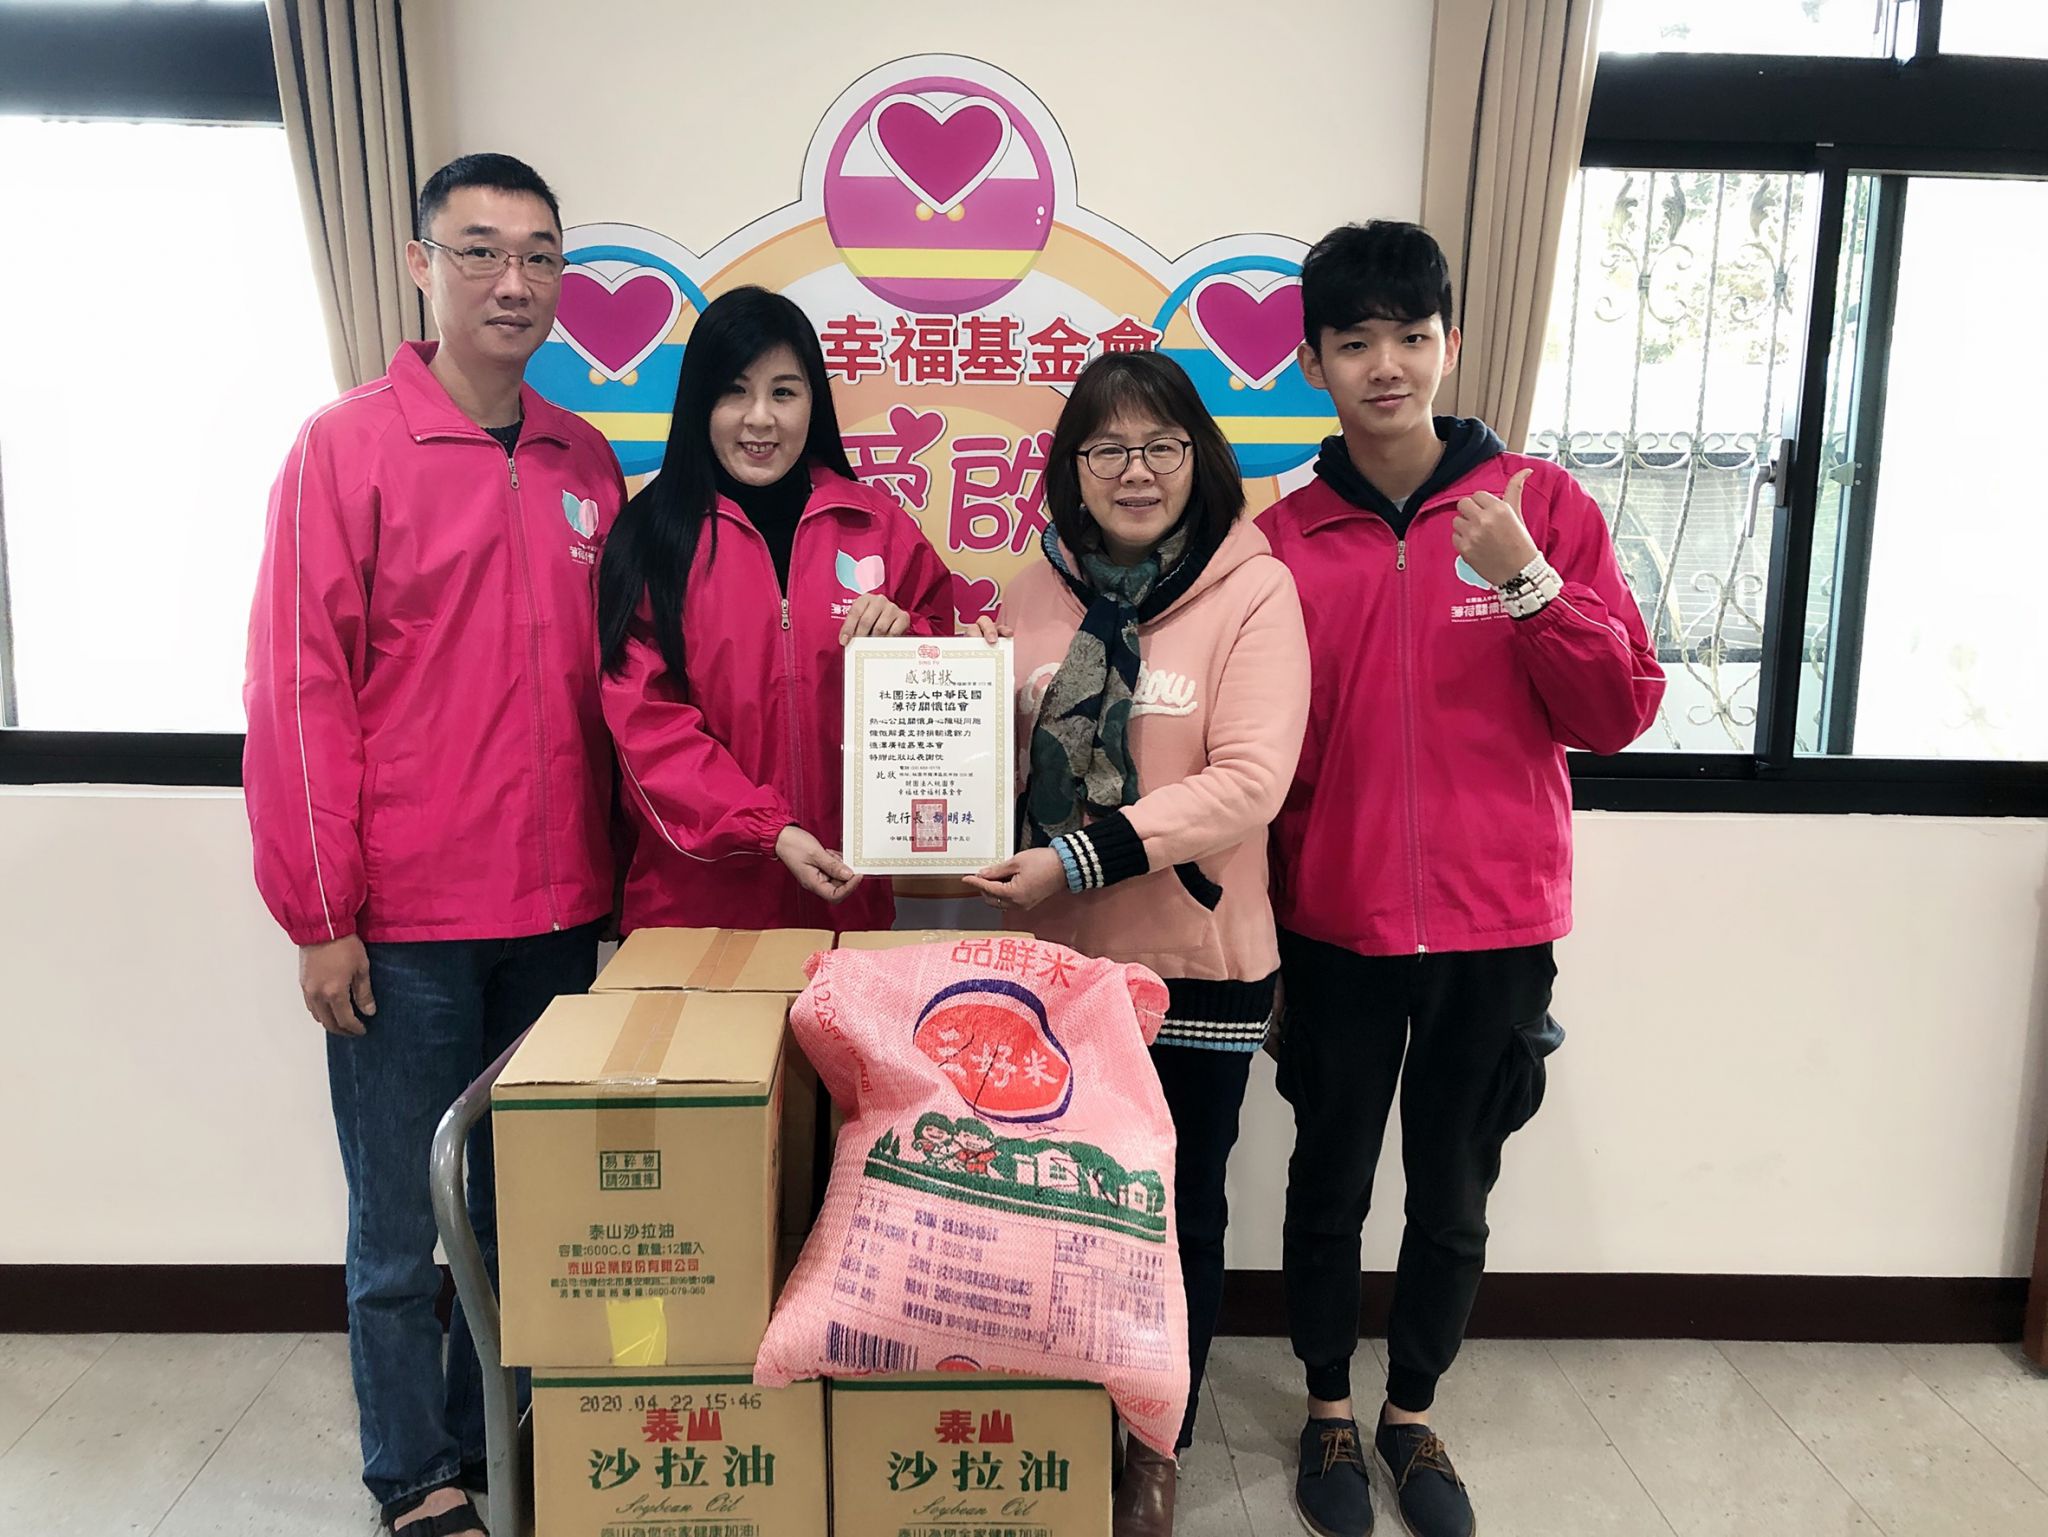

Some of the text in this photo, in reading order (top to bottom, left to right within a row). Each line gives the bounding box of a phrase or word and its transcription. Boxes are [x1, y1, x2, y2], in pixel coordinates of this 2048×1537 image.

[905, 669, 955, 685] 感謝狀
[879, 690, 982, 700] 社團法人中華民國
[892, 701, 969, 712] 薄荷關懷協會
[605, 1153, 655, 1169] 易碎物
[605, 1172, 655, 1187] 請勿重摔
[589, 1223, 675, 1240] 泰山沙拉油
[568, 1258, 700, 1275] 泰山企業股份有限公司
[705, 1392, 762, 1410] 15:46
[641, 1407, 723, 1443] 泰山
[934, 1409, 1014, 1444] 泰山
[588, 1444, 775, 1491] 沙拉油
[887, 1450, 1070, 1492] 沙拉油
[615, 1492, 745, 1520] Soybean Oil
[913, 1496, 1039, 1521] Soybean Oil
